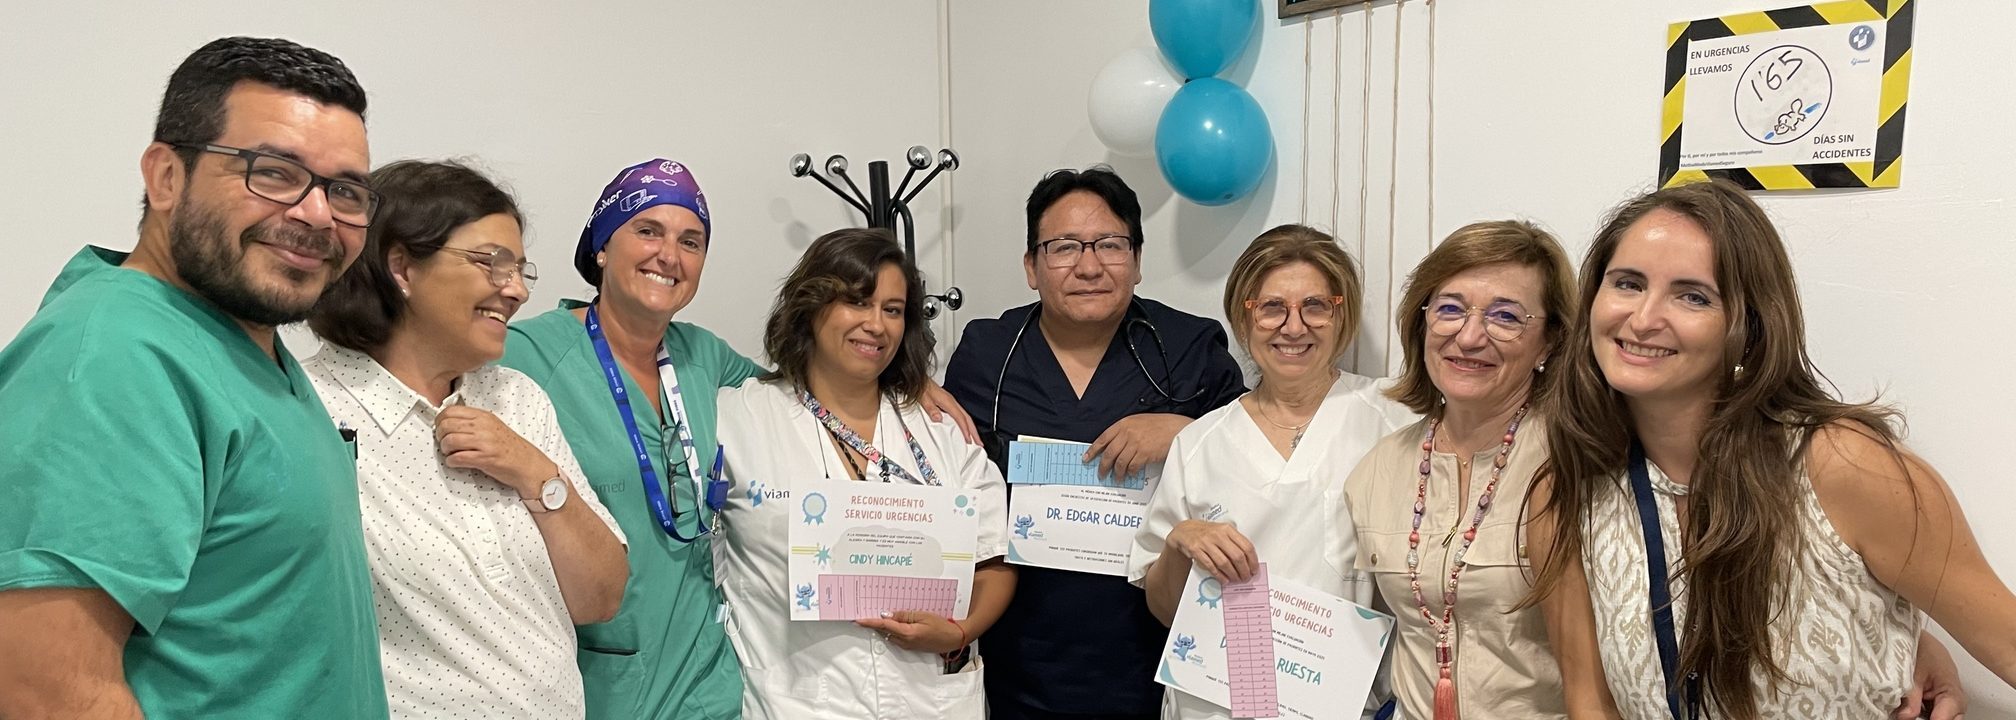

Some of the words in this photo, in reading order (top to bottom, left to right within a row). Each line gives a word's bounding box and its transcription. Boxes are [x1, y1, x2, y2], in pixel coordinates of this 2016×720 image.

[1691, 51, 1702, 59] EN
[1704, 45, 1750, 58] URGENCIAS
[1690, 64, 1732, 75] LLEVAMOS
[1814, 134, 1836, 145] DÍAS
[1838, 134, 1855, 144] SIN
[1812, 148, 1872, 159] ACCIDENTES
[851, 495, 925, 509] RECONOCIMIENTO
[844, 508, 883, 520] SERVICIO
[886, 511, 934, 523] URGENCIAS
[1046, 506, 1063, 520] DR.
[1066, 508, 1100, 525] EDGAR
[849, 553, 874, 565] CINDY
[876, 552, 913, 567] HINCAPIÉ
[1284, 611, 1334, 638] URGENCIAS
[1276, 657, 1322, 686] RUESTA
